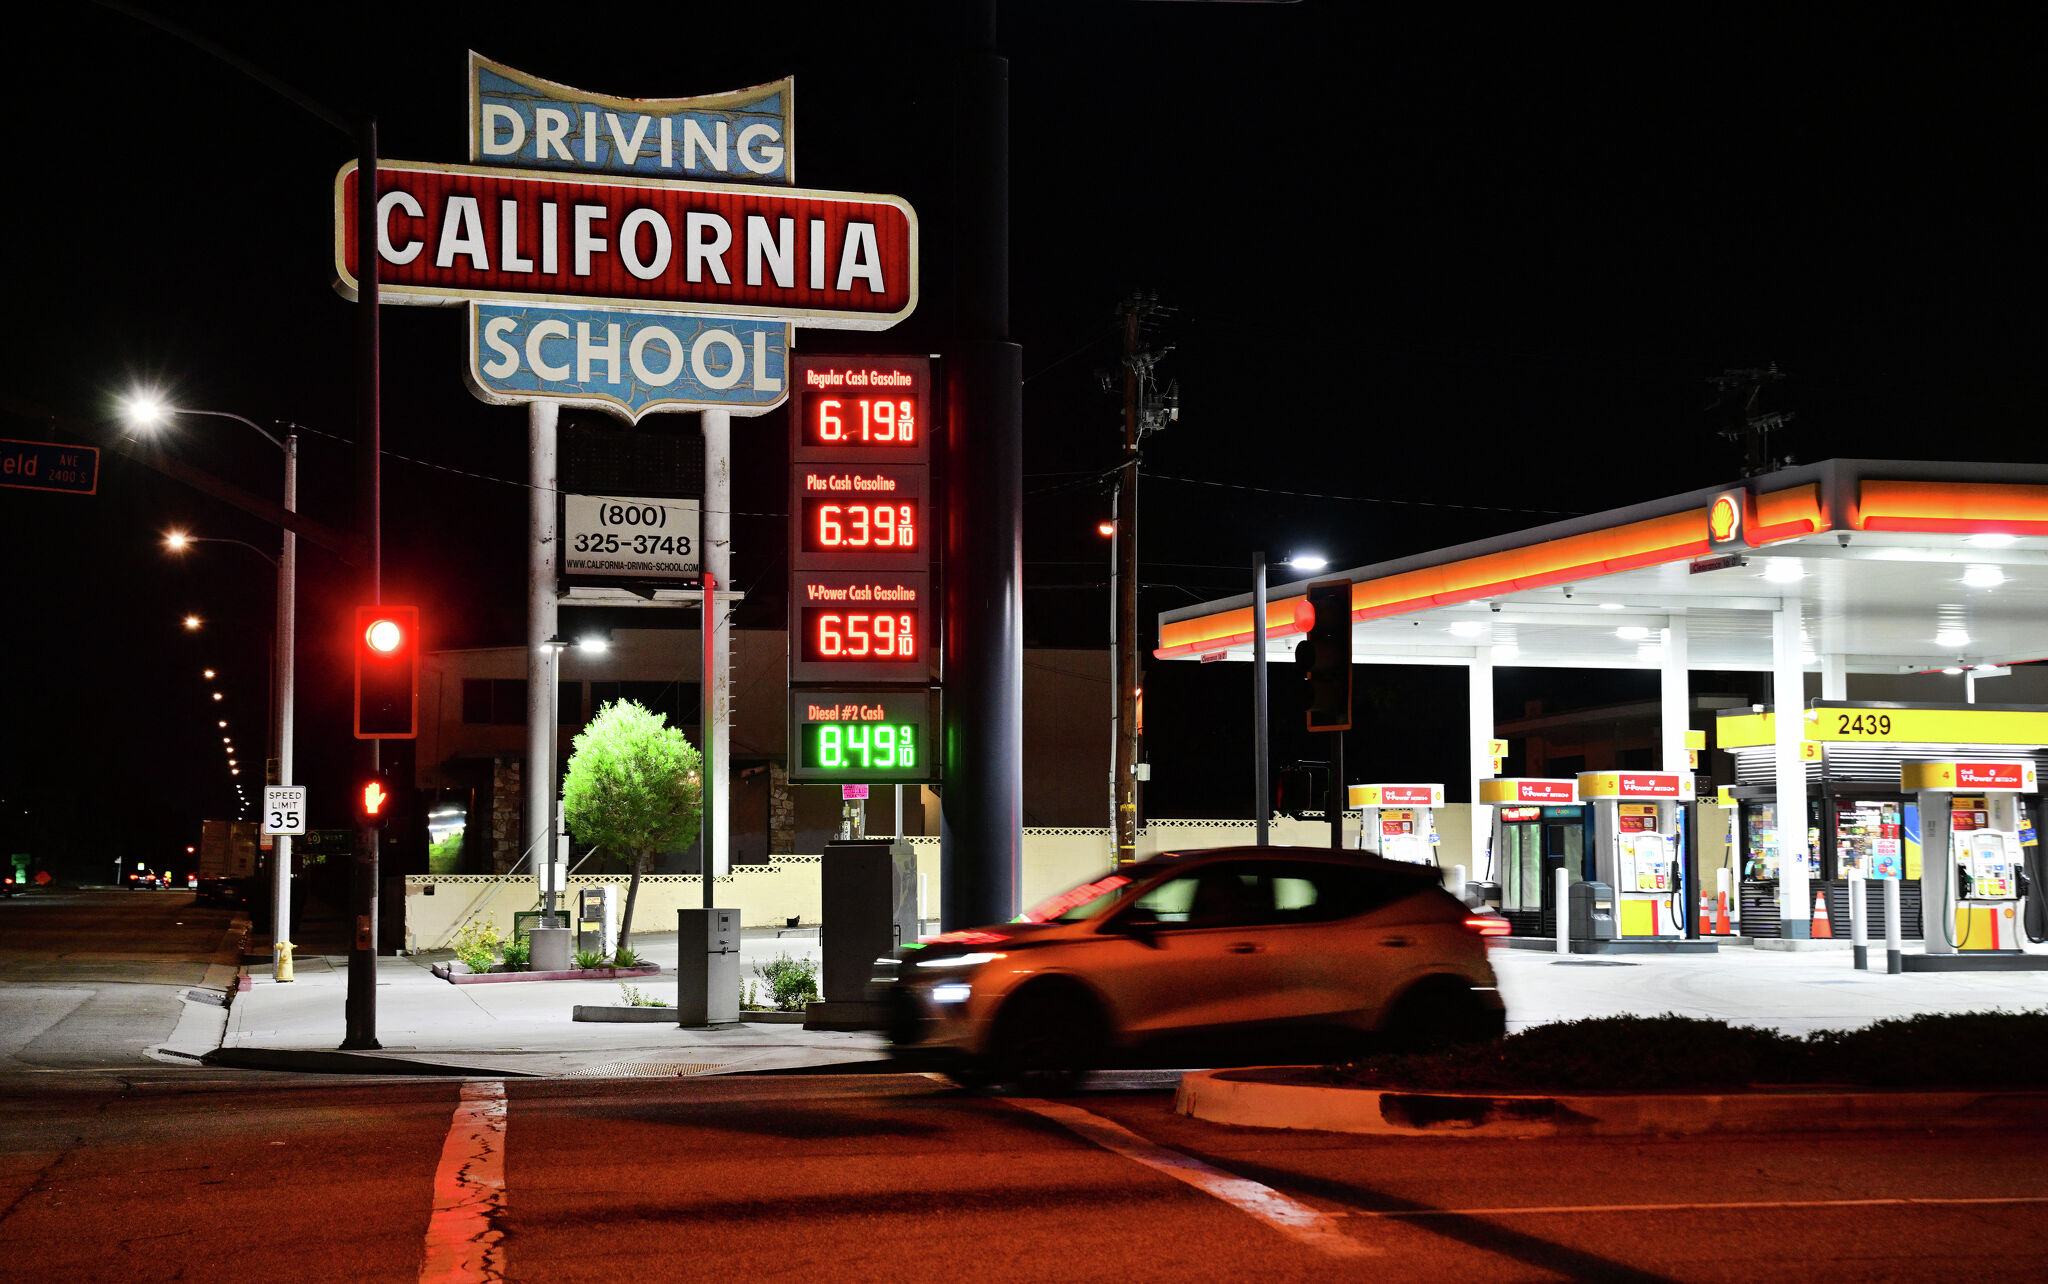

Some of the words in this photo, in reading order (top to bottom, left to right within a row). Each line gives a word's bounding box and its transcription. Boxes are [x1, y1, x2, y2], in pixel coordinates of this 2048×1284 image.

[480, 103, 785, 174] DRIVING
[376, 190, 886, 294] CALIFORNIA
[482, 316, 782, 393] SCHOOL
[807, 369, 844, 389] Regular
[845, 370, 868, 386] Cash
[870, 370, 912, 386] Gasoline
[819, 400, 895, 441] 6.19
[0, 450, 38, 477] eld
[59, 454, 79, 467] AVE
[48, 469, 76, 483] 2400
[807, 474, 827, 491] Plus
[829, 475, 852, 491] Cash
[853, 475, 895, 491] Gasoline
[600, 503, 666, 528] (800)
[819, 505, 895, 546] 6.39
[574, 532, 691, 556] 325-3748
[566, 559, 699, 573] WWW.CALIFORNIA-DRIVING-SCHOOL.COM
[807, 584, 847, 600] V-Power
[849, 585, 872, 600] Cash
[874, 585, 916, 601] Gasoline
[819, 615, 895, 656] 6.59
[808, 704, 839, 721] Diesel
[841, 705, 858, 720] #2
[860, 705, 884, 720] Cash
[1838, 714, 1892, 736] 2439
[819, 725, 896, 767] 8.49
[1494, 743, 1502, 754] 7
[1806, 745, 1814, 757] 5
[1607, 780, 1614, 789] 5
[1942, 771, 1950, 779] 4
[269, 792, 302, 800] SPEED
[269, 811, 300, 829] 35
